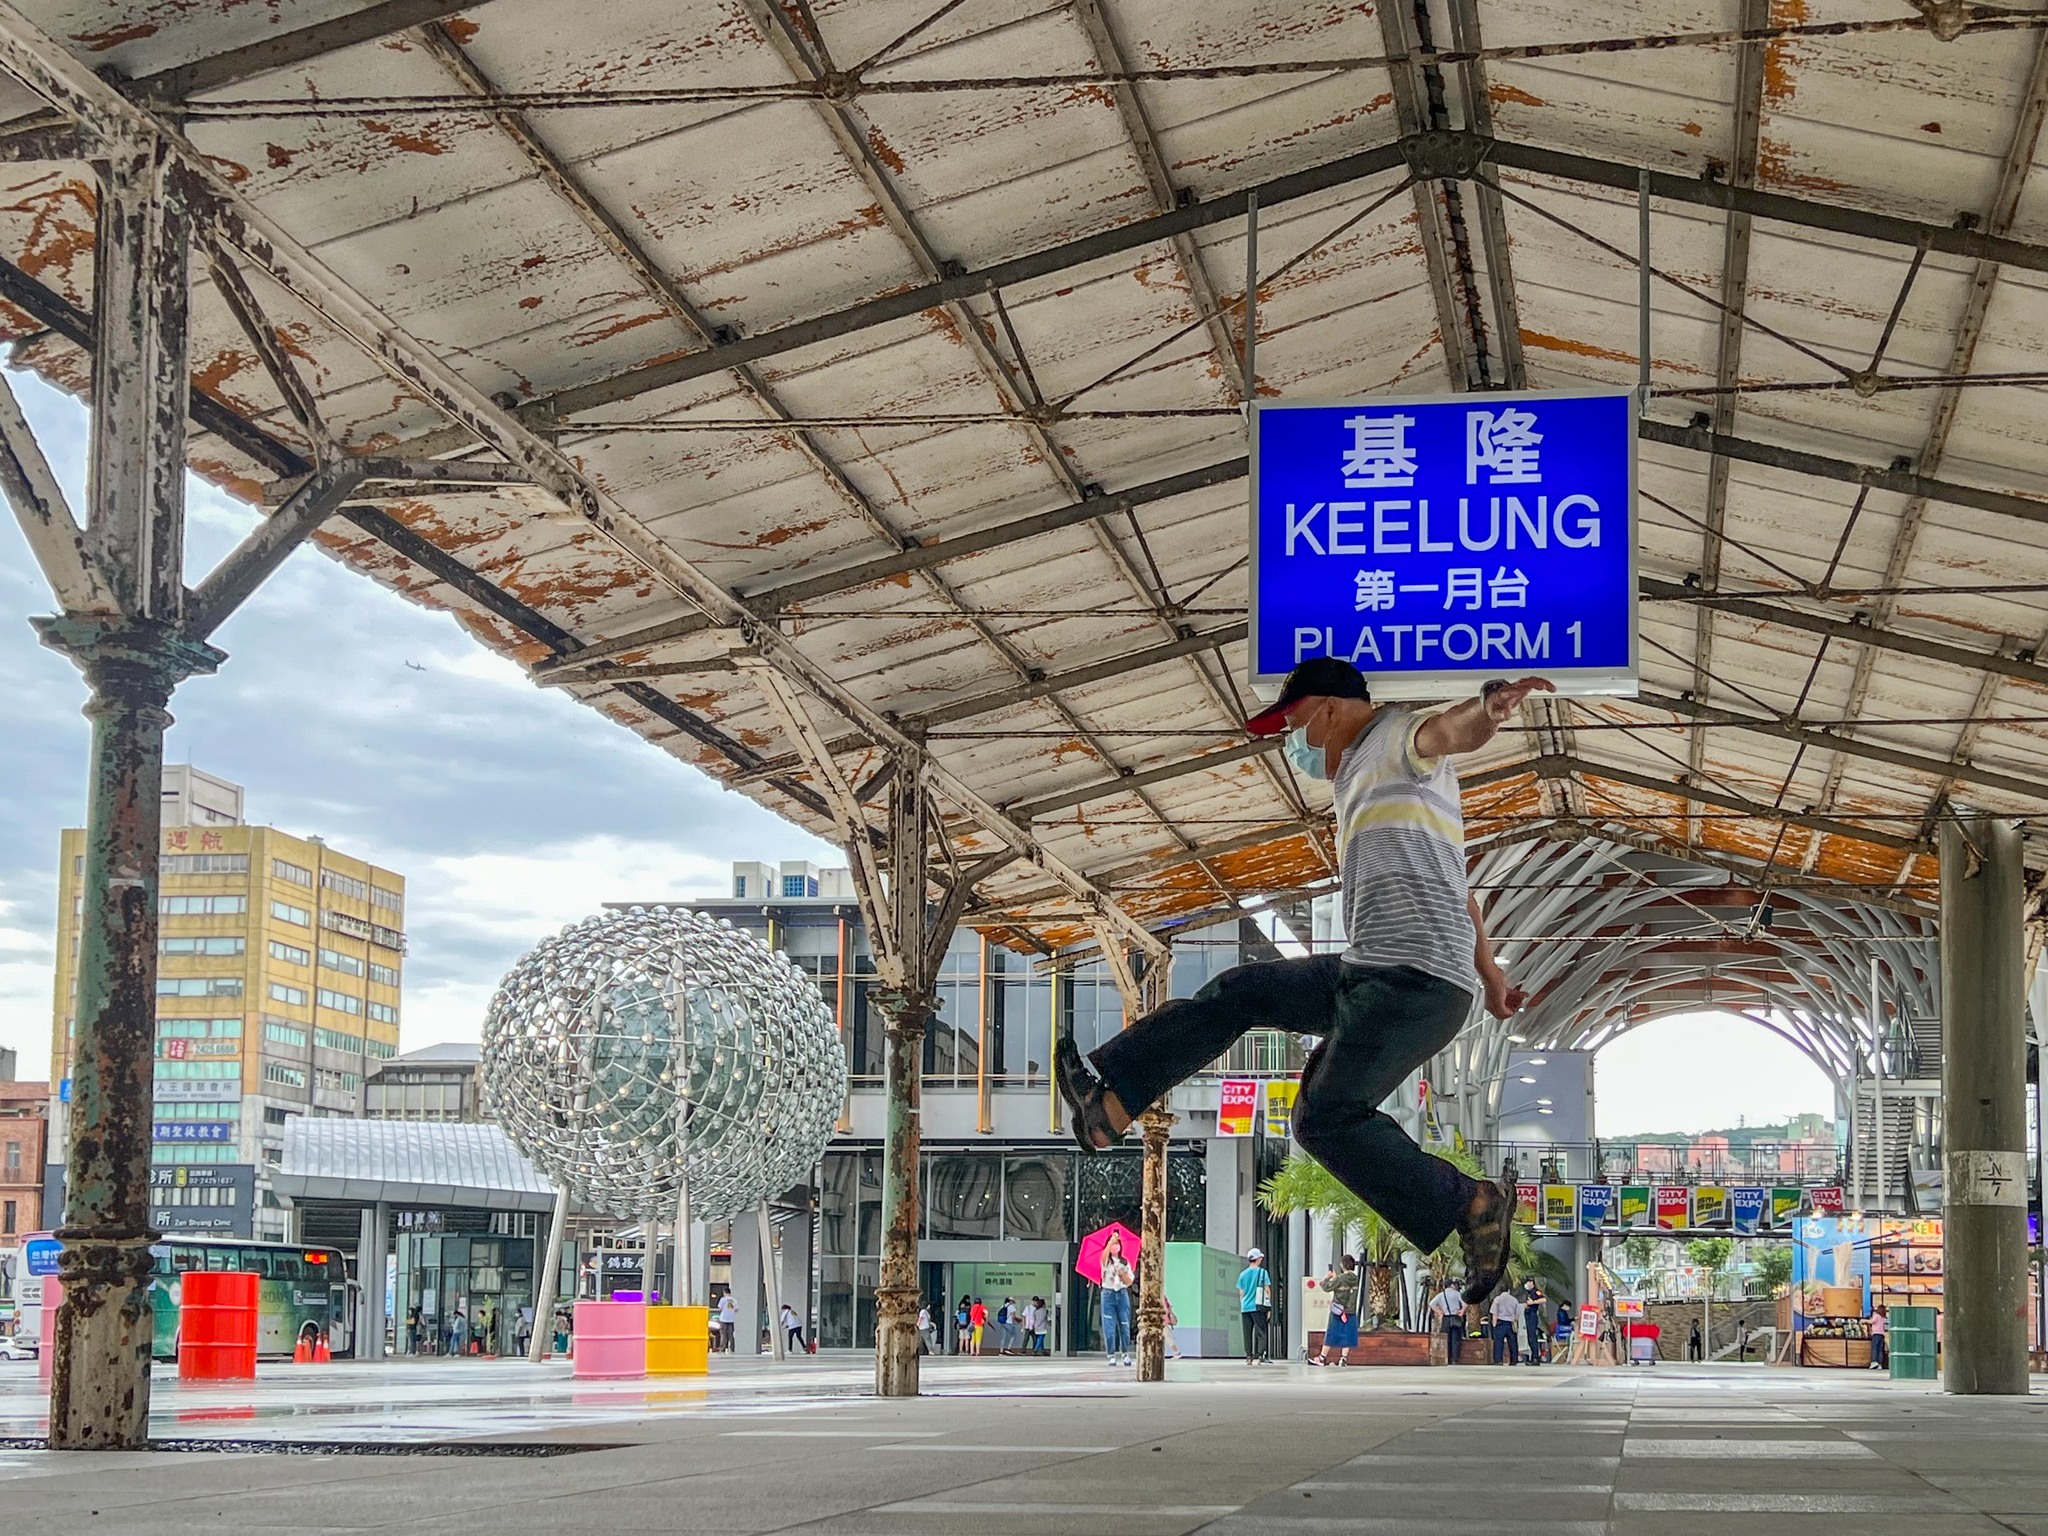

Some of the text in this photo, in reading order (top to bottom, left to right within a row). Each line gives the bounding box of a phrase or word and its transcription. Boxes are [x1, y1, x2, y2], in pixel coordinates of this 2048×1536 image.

[1340, 407, 1545, 489] 基隆
[1284, 494, 1602, 556] KEELUNG
[1354, 565, 1530, 612] 第一月台
[1294, 620, 1583, 664] PLATFORM 1
[1223, 1085, 1251, 1094] CITY
[1223, 1095, 1254, 1105] EXPO
[1583, 1189, 1608, 1198] CITY
[1658, 1190, 1684, 1198] CITY
[1735, 1191, 1760, 1199] CITY
[1812, 1191, 1837, 1199] CITY
[1583, 1198, 1613, 1207] EXPO
[1658, 1198, 1687, 1206] EXPO
[1735, 1199, 1764, 1208] EXPO
[1814, 1198, 1843, 1206] EXPO
